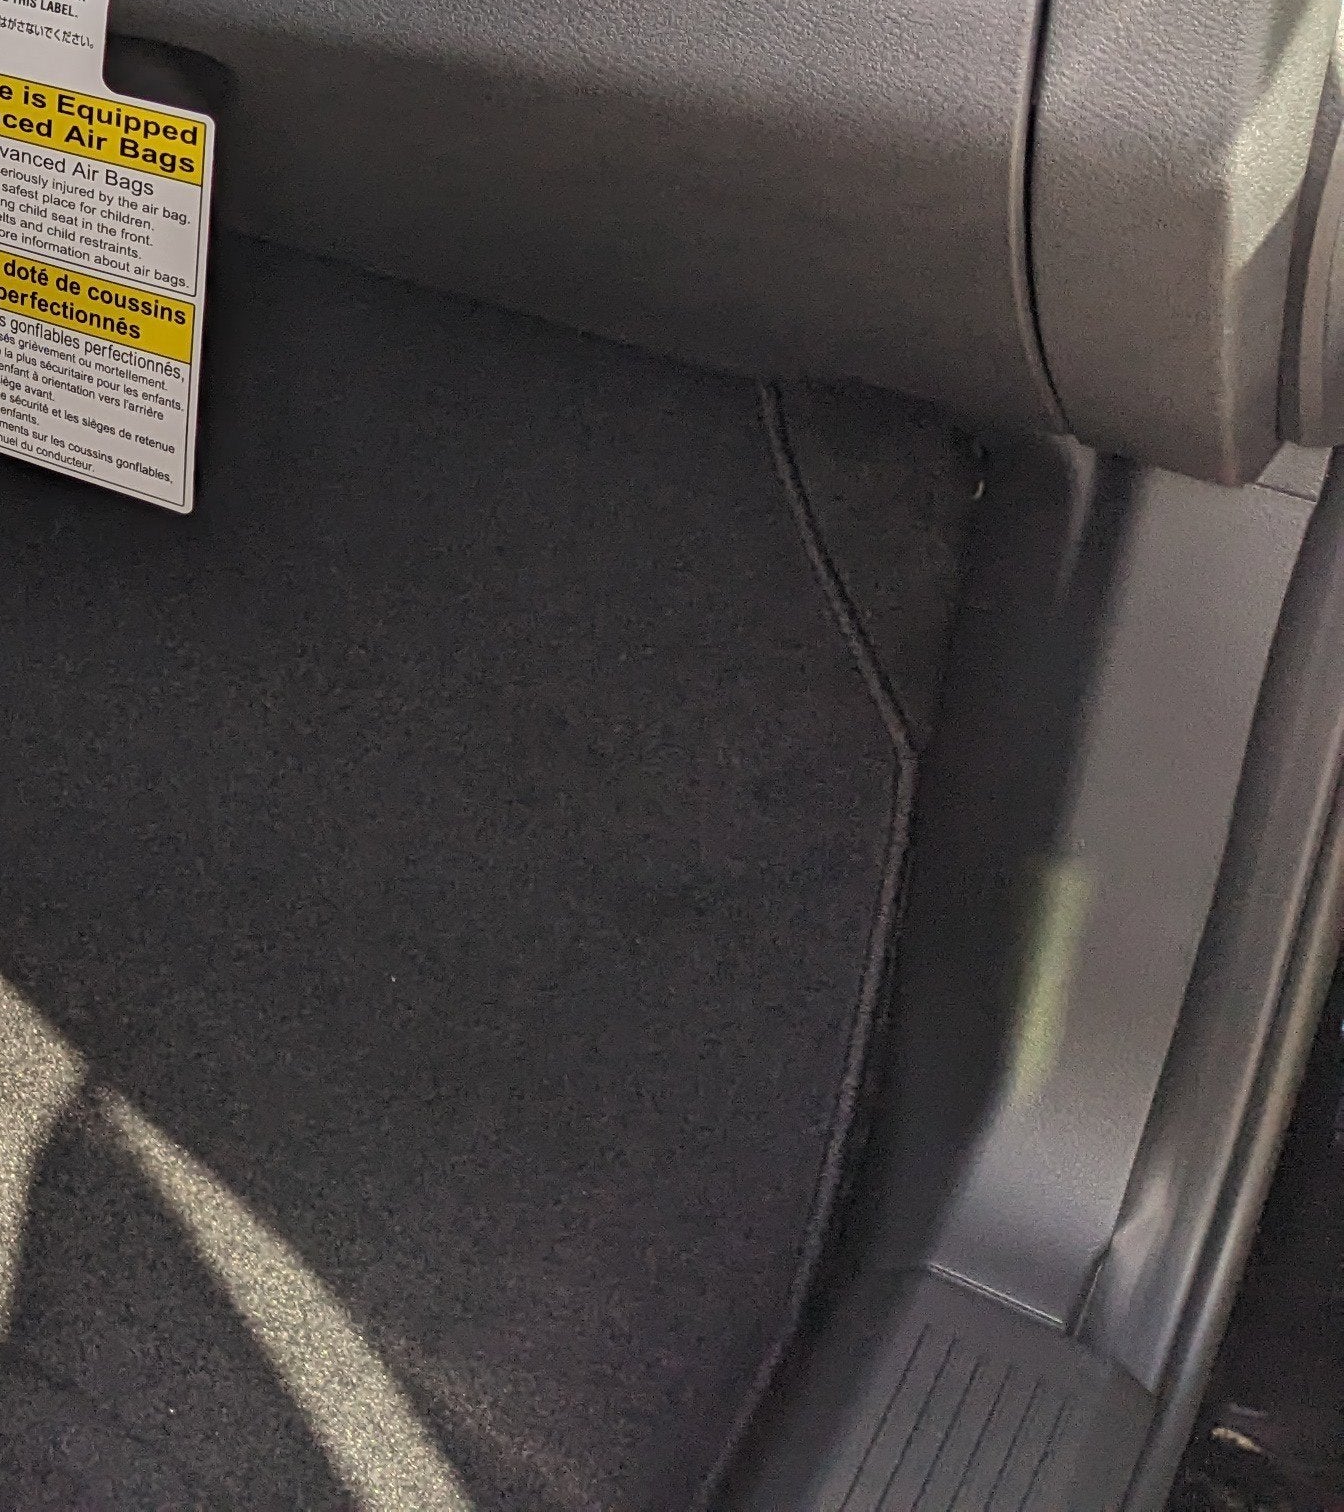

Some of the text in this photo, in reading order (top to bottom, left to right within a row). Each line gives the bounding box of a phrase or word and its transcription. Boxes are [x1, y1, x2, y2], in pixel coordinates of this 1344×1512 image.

[40, 0, 78, 18] LABEL.
[23, 85, 47, 109] is
[57, 93, 198, 146] Equipped
[63, 125, 108, 151] Air
[119, 136, 195, 174] Bags
[52, 178, 95, 200] injured
[98, 190, 114, 207] by
[117, 195, 138, 211] the
[141, 203, 160, 216] air
[71, 161, 100, 182] Air
[105, 168, 154, 197] Bags
[1, 183, 39, 201] safest
[42, 193, 76, 210] place
[79, 201, 97, 216] for
[18, 203, 48, 219] child
[51, 212, 78, 227] seat
[81, 217, 93, 231] in
[96, 222, 117, 237] the
[19, 219, 43, 233] and
[46, 225, 76, 242] child
[21, 232, 90, 262] information
[93, 254, 130, 273] about
[133, 265, 151, 277] air
[3, 259, 49, 287] doté
[55, 273, 81, 296] de
[87, 286, 186, 326] coussins
[10, 318, 80, 350] gonflables
